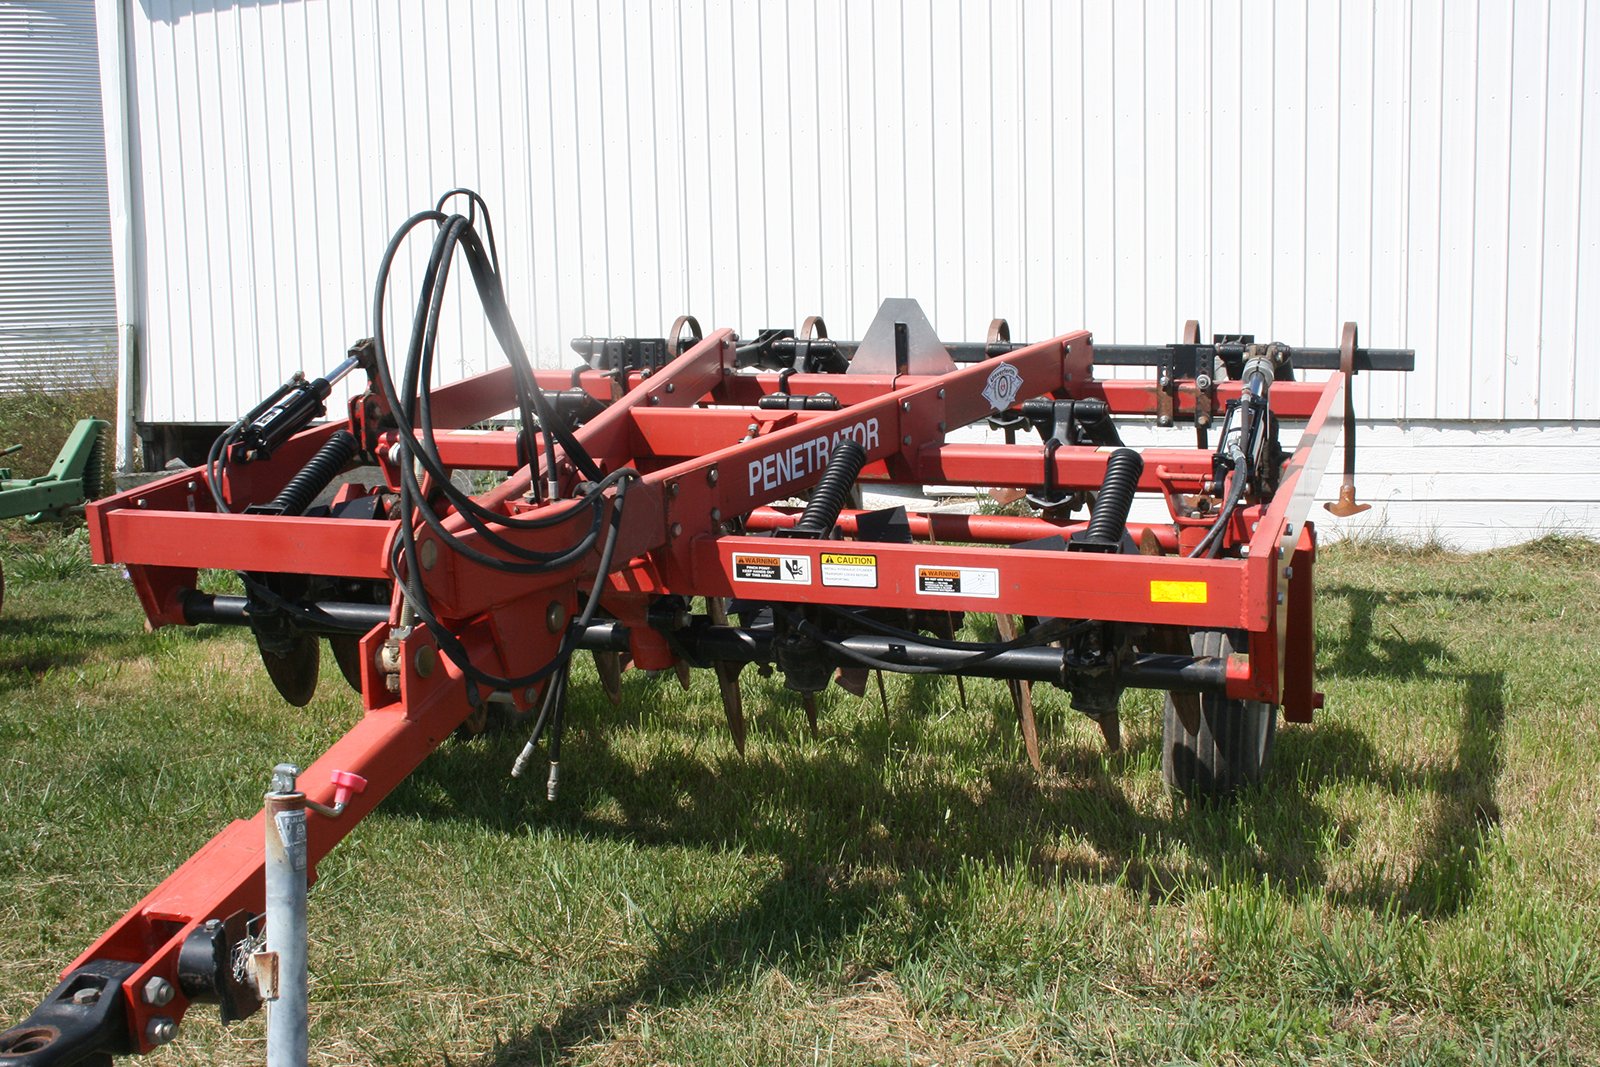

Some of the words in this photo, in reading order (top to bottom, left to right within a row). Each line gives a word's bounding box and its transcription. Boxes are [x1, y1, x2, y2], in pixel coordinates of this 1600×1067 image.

[748, 417, 880, 497] PENETRATOR
[745, 557, 779, 566] WARNING
[836, 557, 873, 565] CAUTION
